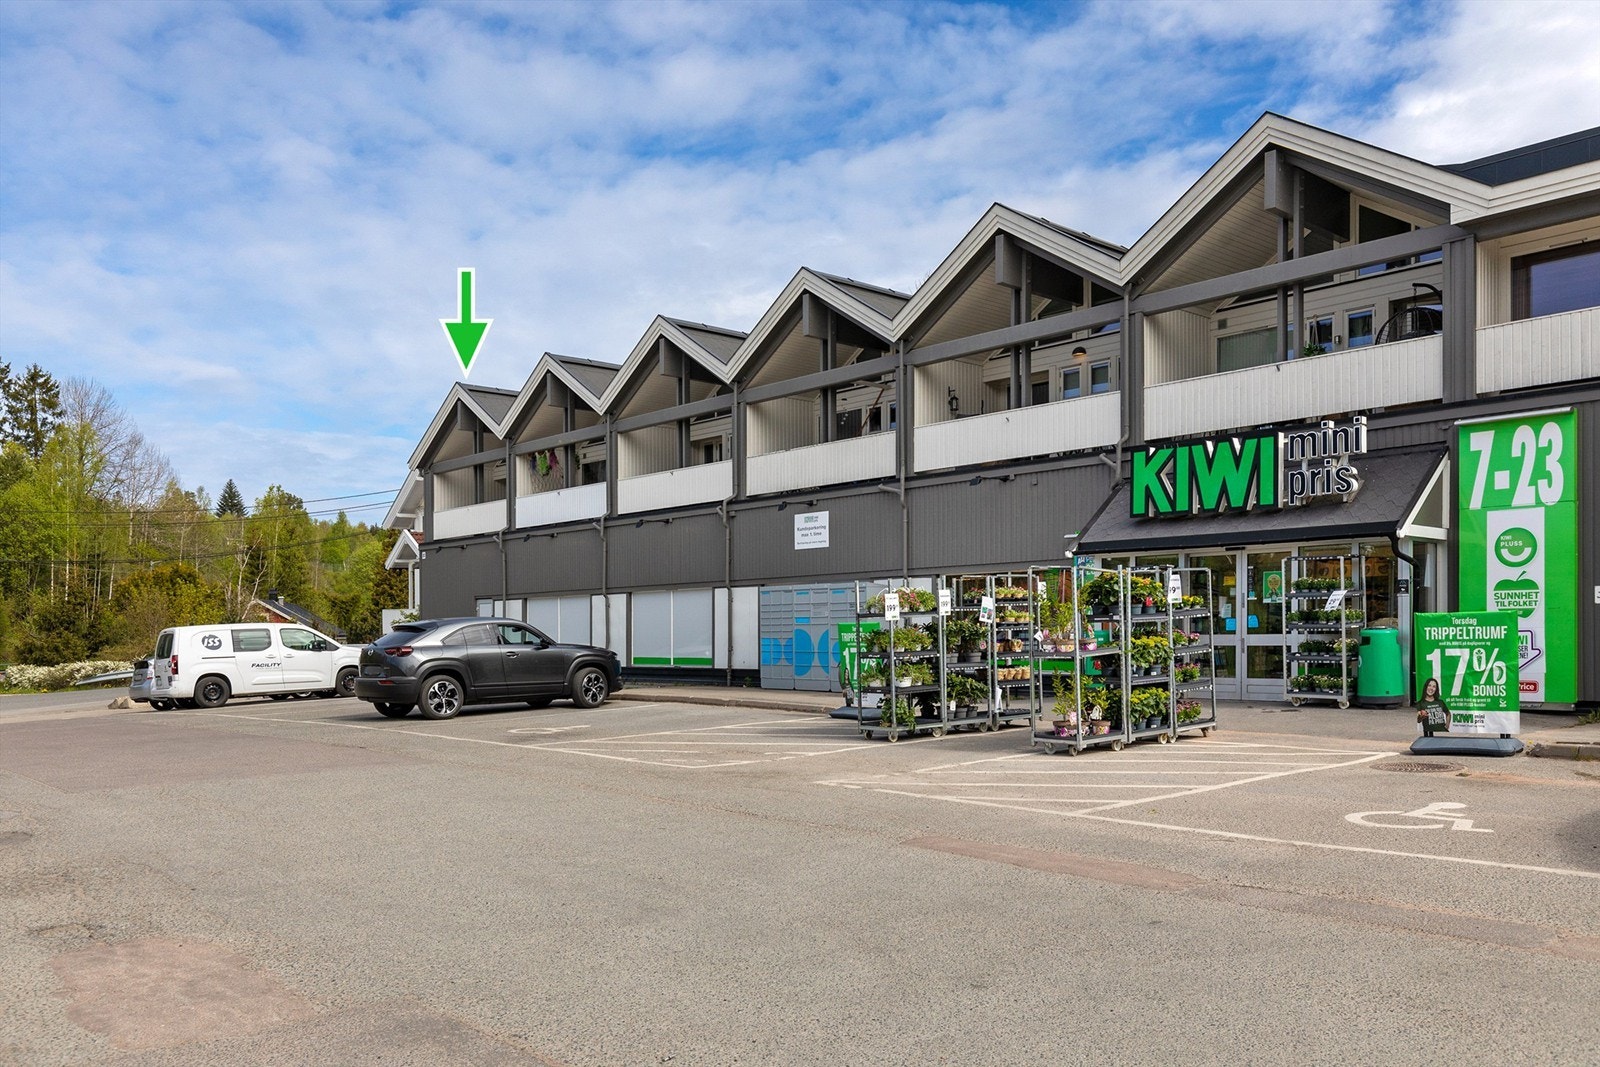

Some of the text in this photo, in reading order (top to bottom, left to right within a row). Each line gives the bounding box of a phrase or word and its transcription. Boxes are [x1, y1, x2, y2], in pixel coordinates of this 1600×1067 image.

[1288, 416, 1366, 461] mini
[1131, 434, 1277, 517] KIWI
[1469, 421, 1564, 510] 7-23
[1288, 459, 1357, 505] pris
[1493, 591, 1540, 600] SUNNHET
[1424, 626, 1508, 640] TRIPPELTRUMF
[1451, 617, 1477, 626] Torsdag
[1426, 648, 1507, 696] 17%
[1472, 685, 1506, 696] BONUS
[1453, 714, 1473, 723] KIWI
